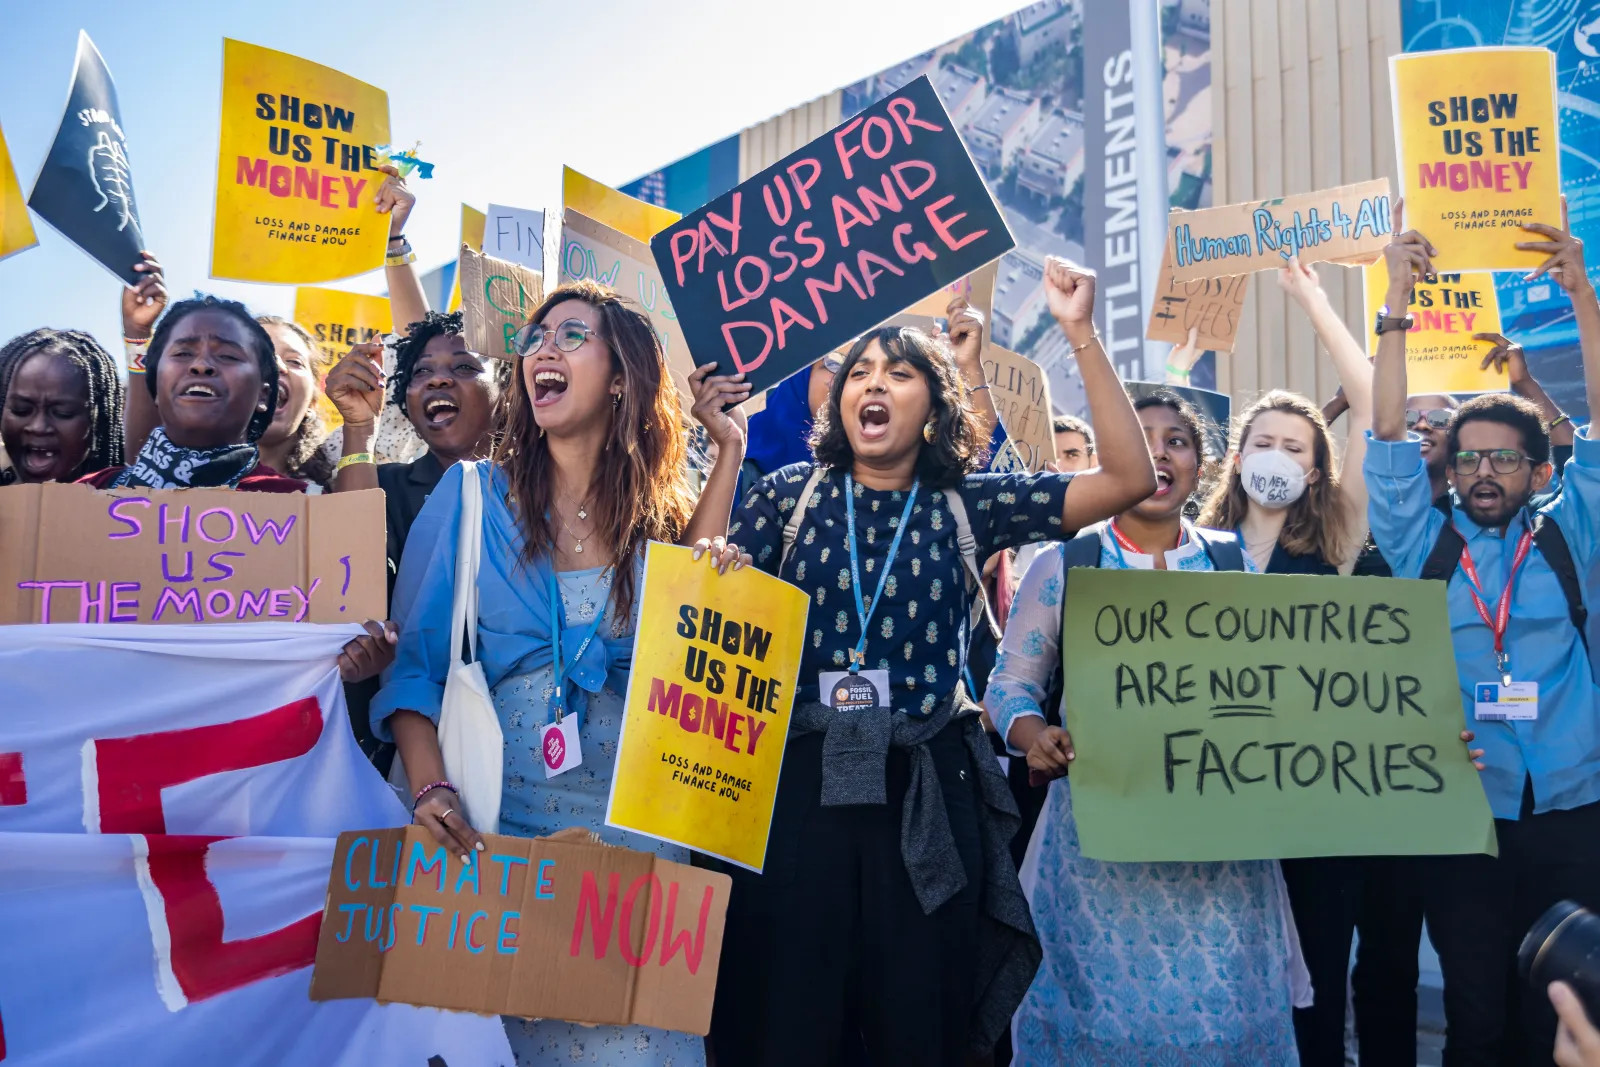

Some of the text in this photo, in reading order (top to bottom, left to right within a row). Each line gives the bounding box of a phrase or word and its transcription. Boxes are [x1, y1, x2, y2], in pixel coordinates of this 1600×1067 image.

[256, 93, 355, 133] SHOW
[1428, 93, 1518, 127] SHOW
[269, 126, 379, 172] US THE
[1443, 127, 1541, 157] US THE
[236, 156, 368, 209] MONEY
[670, 97, 943, 287] PAY UP FOR
[1418, 160, 1533, 193] MONEY
[255, 216, 361, 236] LOSS AND DAMAGE
[1175, 196, 1391, 267] Human Rights 4 All
[1441, 208, 1533, 220] LOSS AND DAMAGE
[1454, 219, 1523, 230] FINANCE NOW
[268, 230, 347, 246] FINANCE NOW
[717, 160, 937, 311] LOSS AND
[721, 195, 988, 373] DAMAGE
[1439, 288, 1483, 309] THE
[1443, 344, 1478, 352] DAMAGE
[1250, 472, 1289, 493] NO NEW
[1267, 488, 1290, 501] GAS
[108, 496, 298, 545] SHOW
[162, 551, 245, 583] US
[18, 579, 141, 624] THE
[152, 577, 321, 623] MONEY
[677, 604, 772, 662] SHOW
[1094, 600, 1411, 646] OUR COUNTRIES
[573, 637, 591, 661] UNFCCC
[684, 645, 782, 714] US THE
[850, 686, 873, 694] FOSSIL
[851, 693, 873, 701] FUEL
[1115, 662, 1428, 717] ARE NOT YOUR
[647, 677, 767, 757] MONEY
[661, 752, 752, 792] LOSS AND DAMAGE
[1163, 728, 1444, 797] FACTORIES
[672, 770, 740, 802] FINANCE NOW
[345, 837, 556, 900] CLIMATE
[336, 902, 521, 955] JUSTICE
[569, 870, 714, 975] NOW
